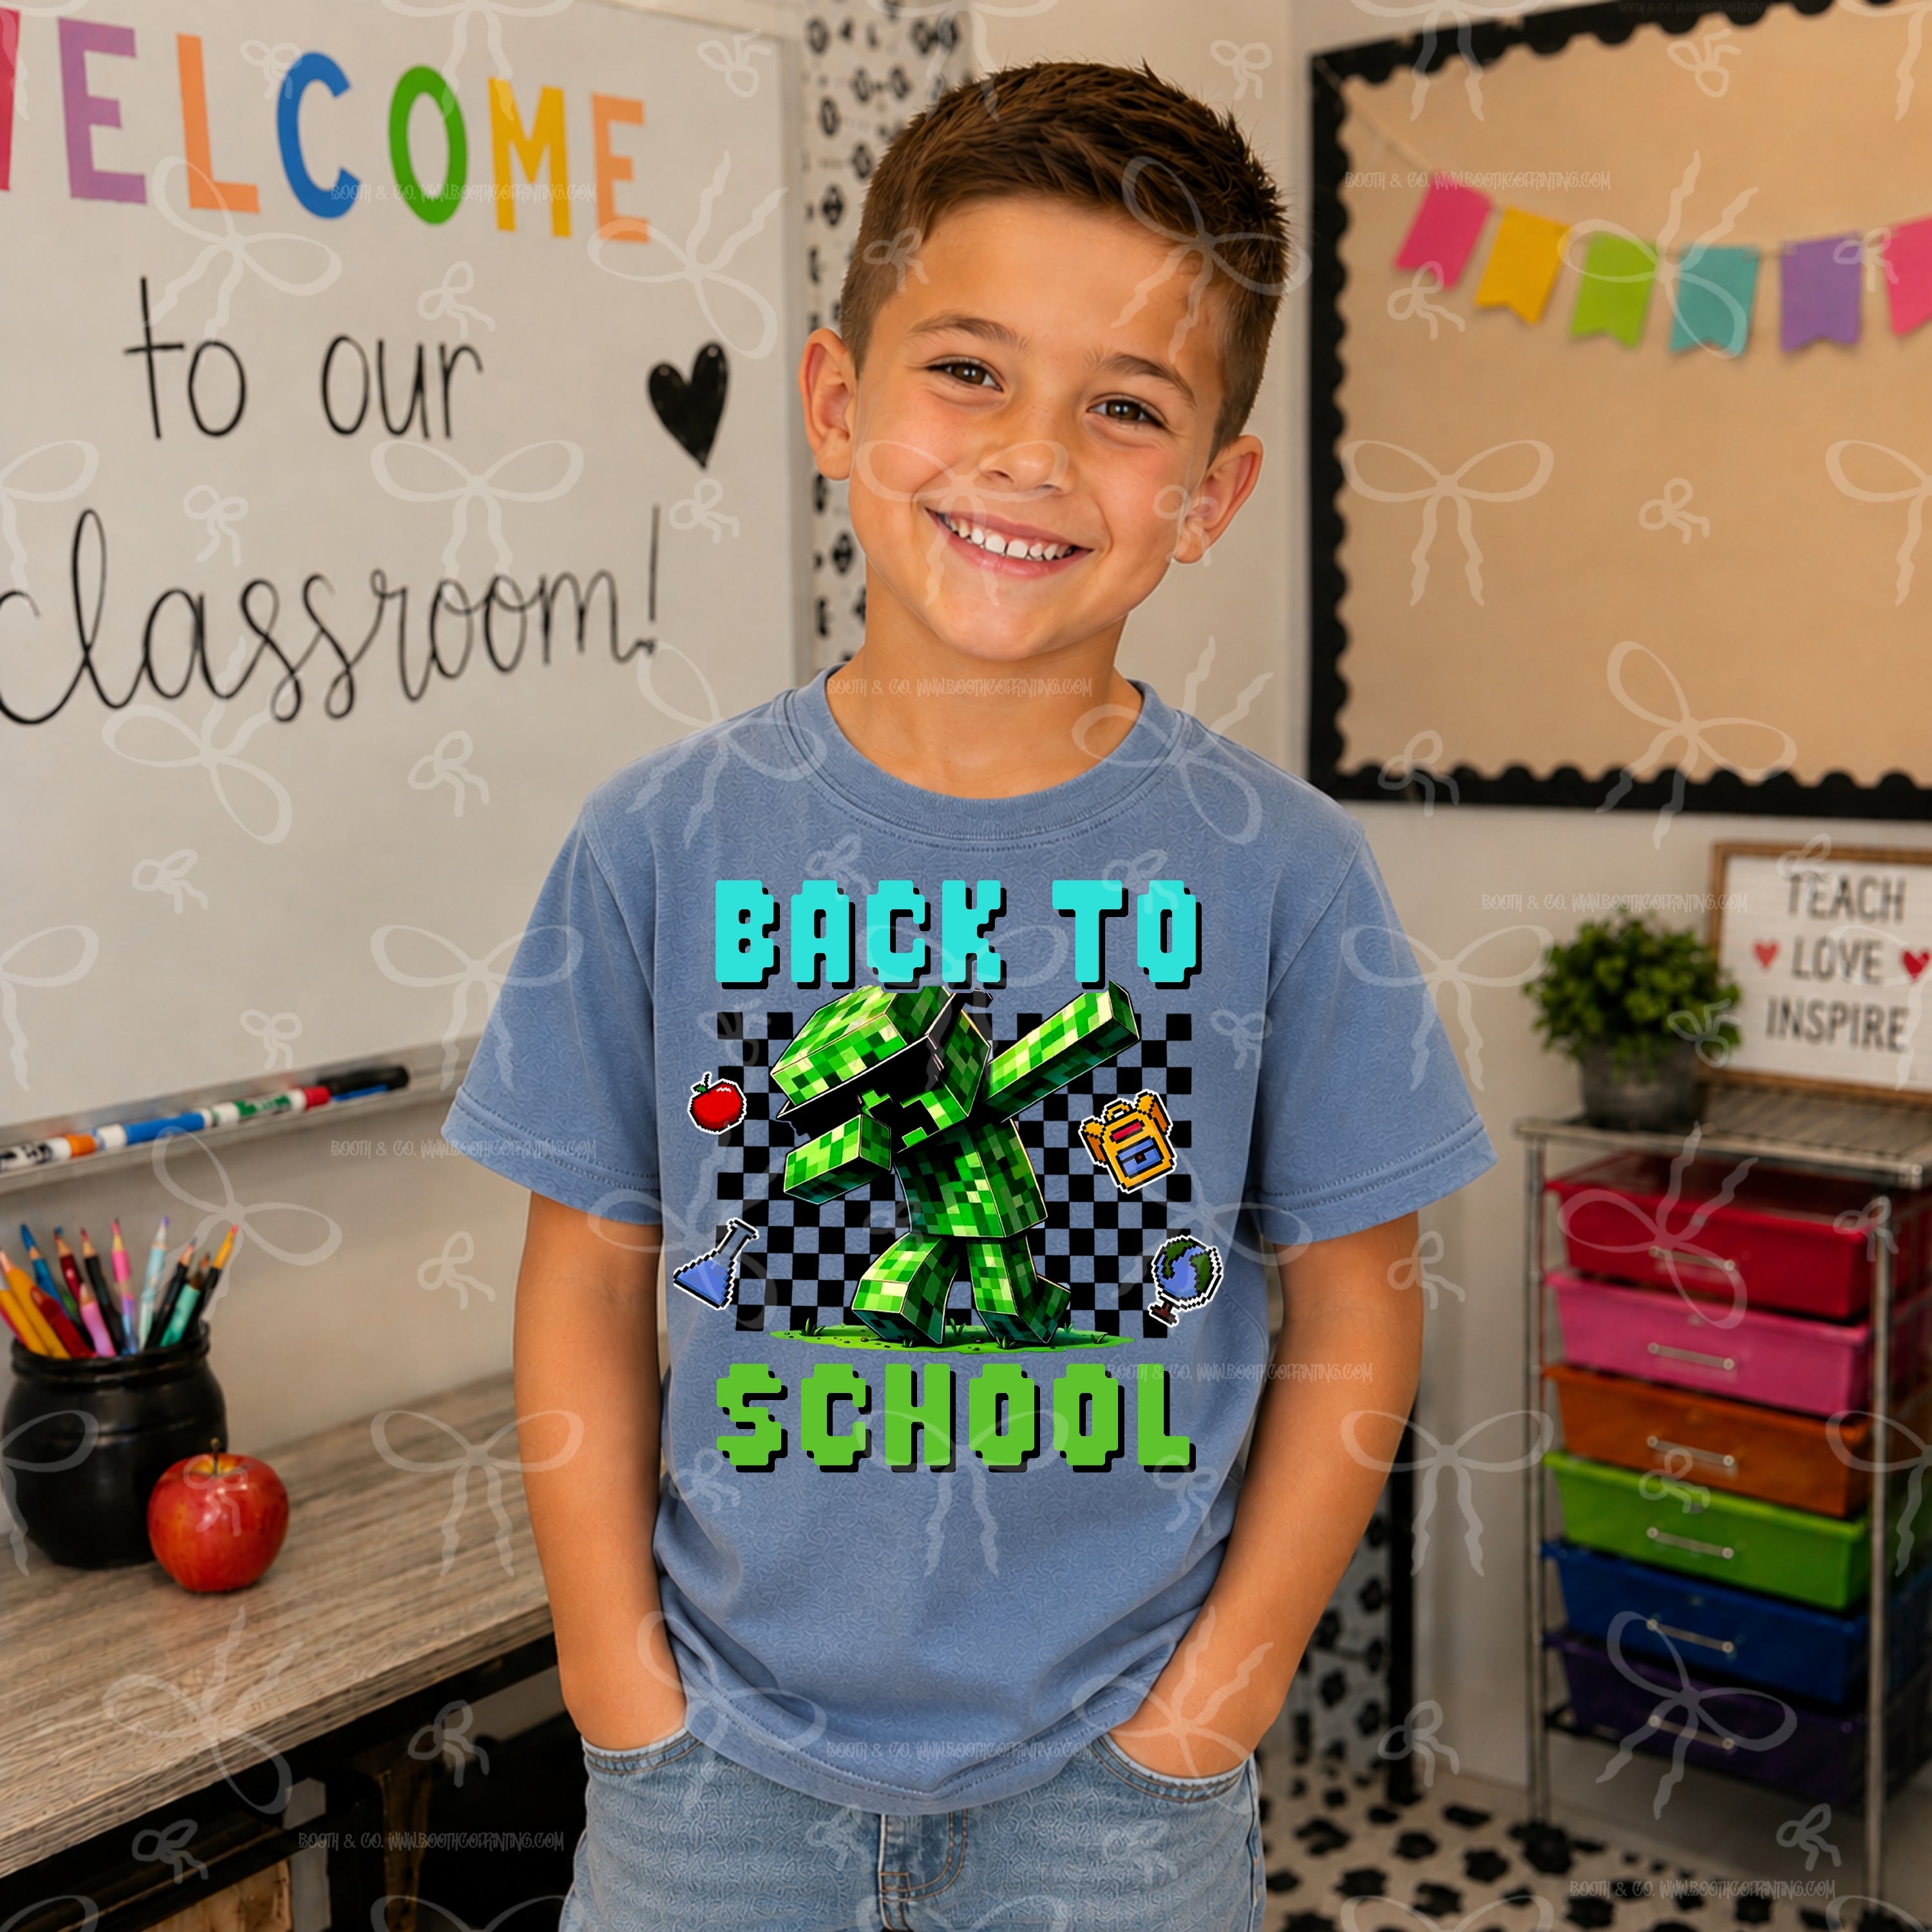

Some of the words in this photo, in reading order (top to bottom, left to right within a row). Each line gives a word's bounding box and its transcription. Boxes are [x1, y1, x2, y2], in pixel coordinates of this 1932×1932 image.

[0, 9, 650, 244] ELCOME
[123, 275, 248, 440] to
[321, 334, 484, 440] our
[0, 505, 661, 724] classroom!
[715, 880, 1007, 989] BACK
[1052, 880, 1202, 989] TO
[1787, 873, 1907, 923] TEACH
[1791, 935, 1884, 985] LOVE
[1766, 996, 1909, 1054] INSPIRE
[717, 1363, 1197, 1473] SCHOOL
